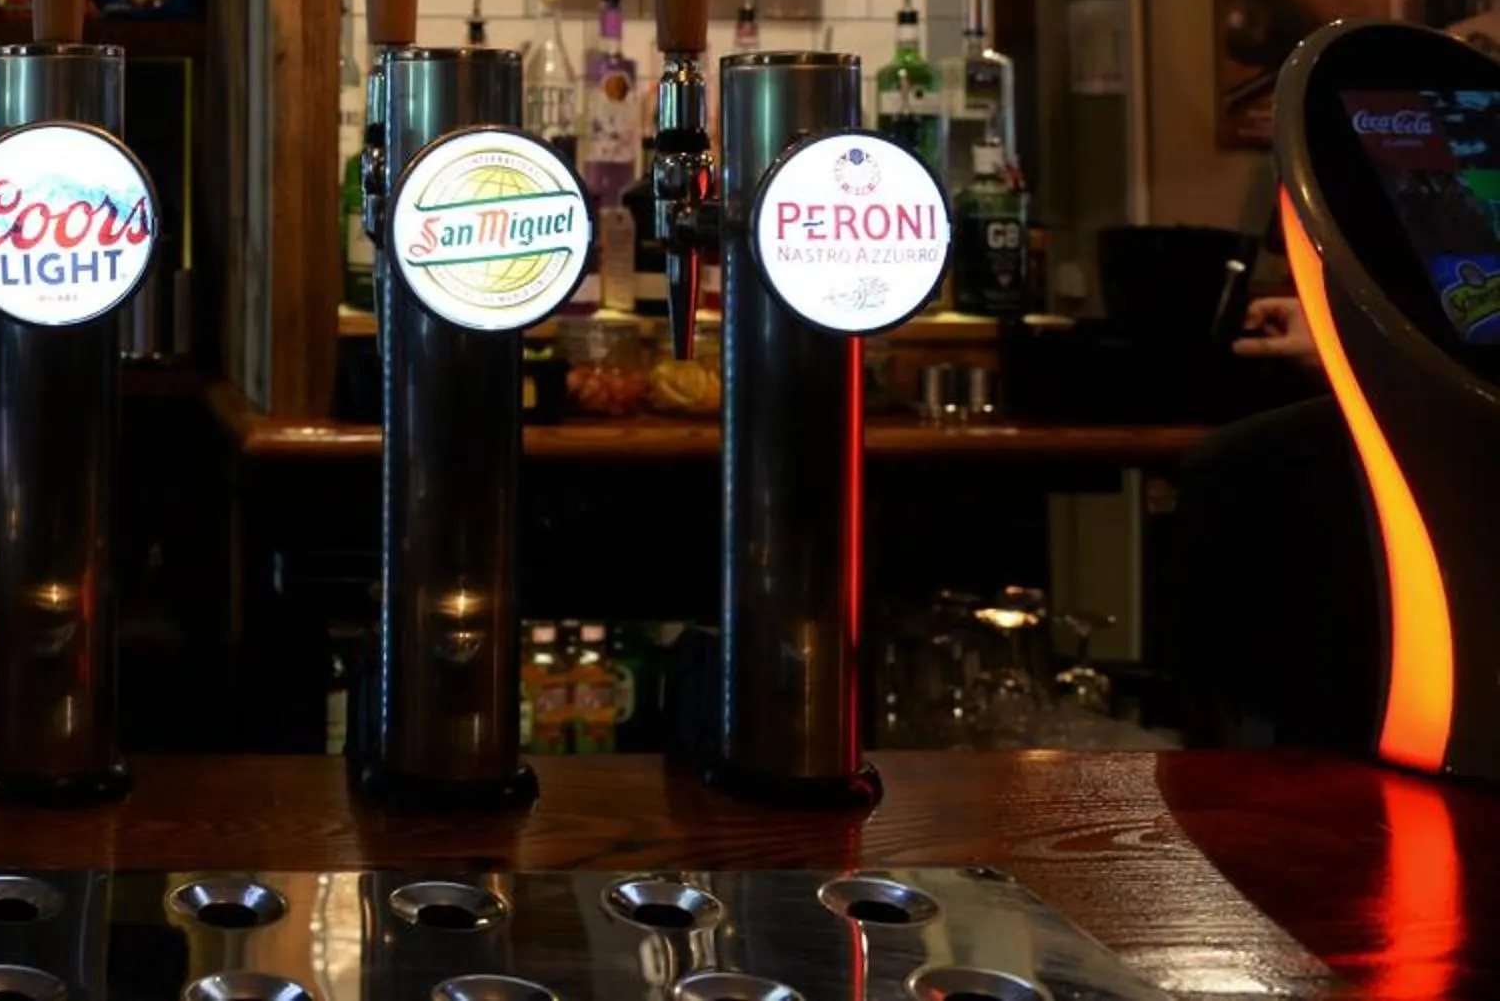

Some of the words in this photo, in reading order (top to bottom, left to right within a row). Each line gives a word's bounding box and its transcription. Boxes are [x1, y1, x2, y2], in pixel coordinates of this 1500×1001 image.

[409, 216, 474, 258] San
[476, 206, 574, 248] Miguel
[777, 202, 936, 240] PERONI
[0, 250, 124, 285] LIGHT
[777, 247, 850, 264] NASTRO
[855, 248, 938, 264] AZZURRO
